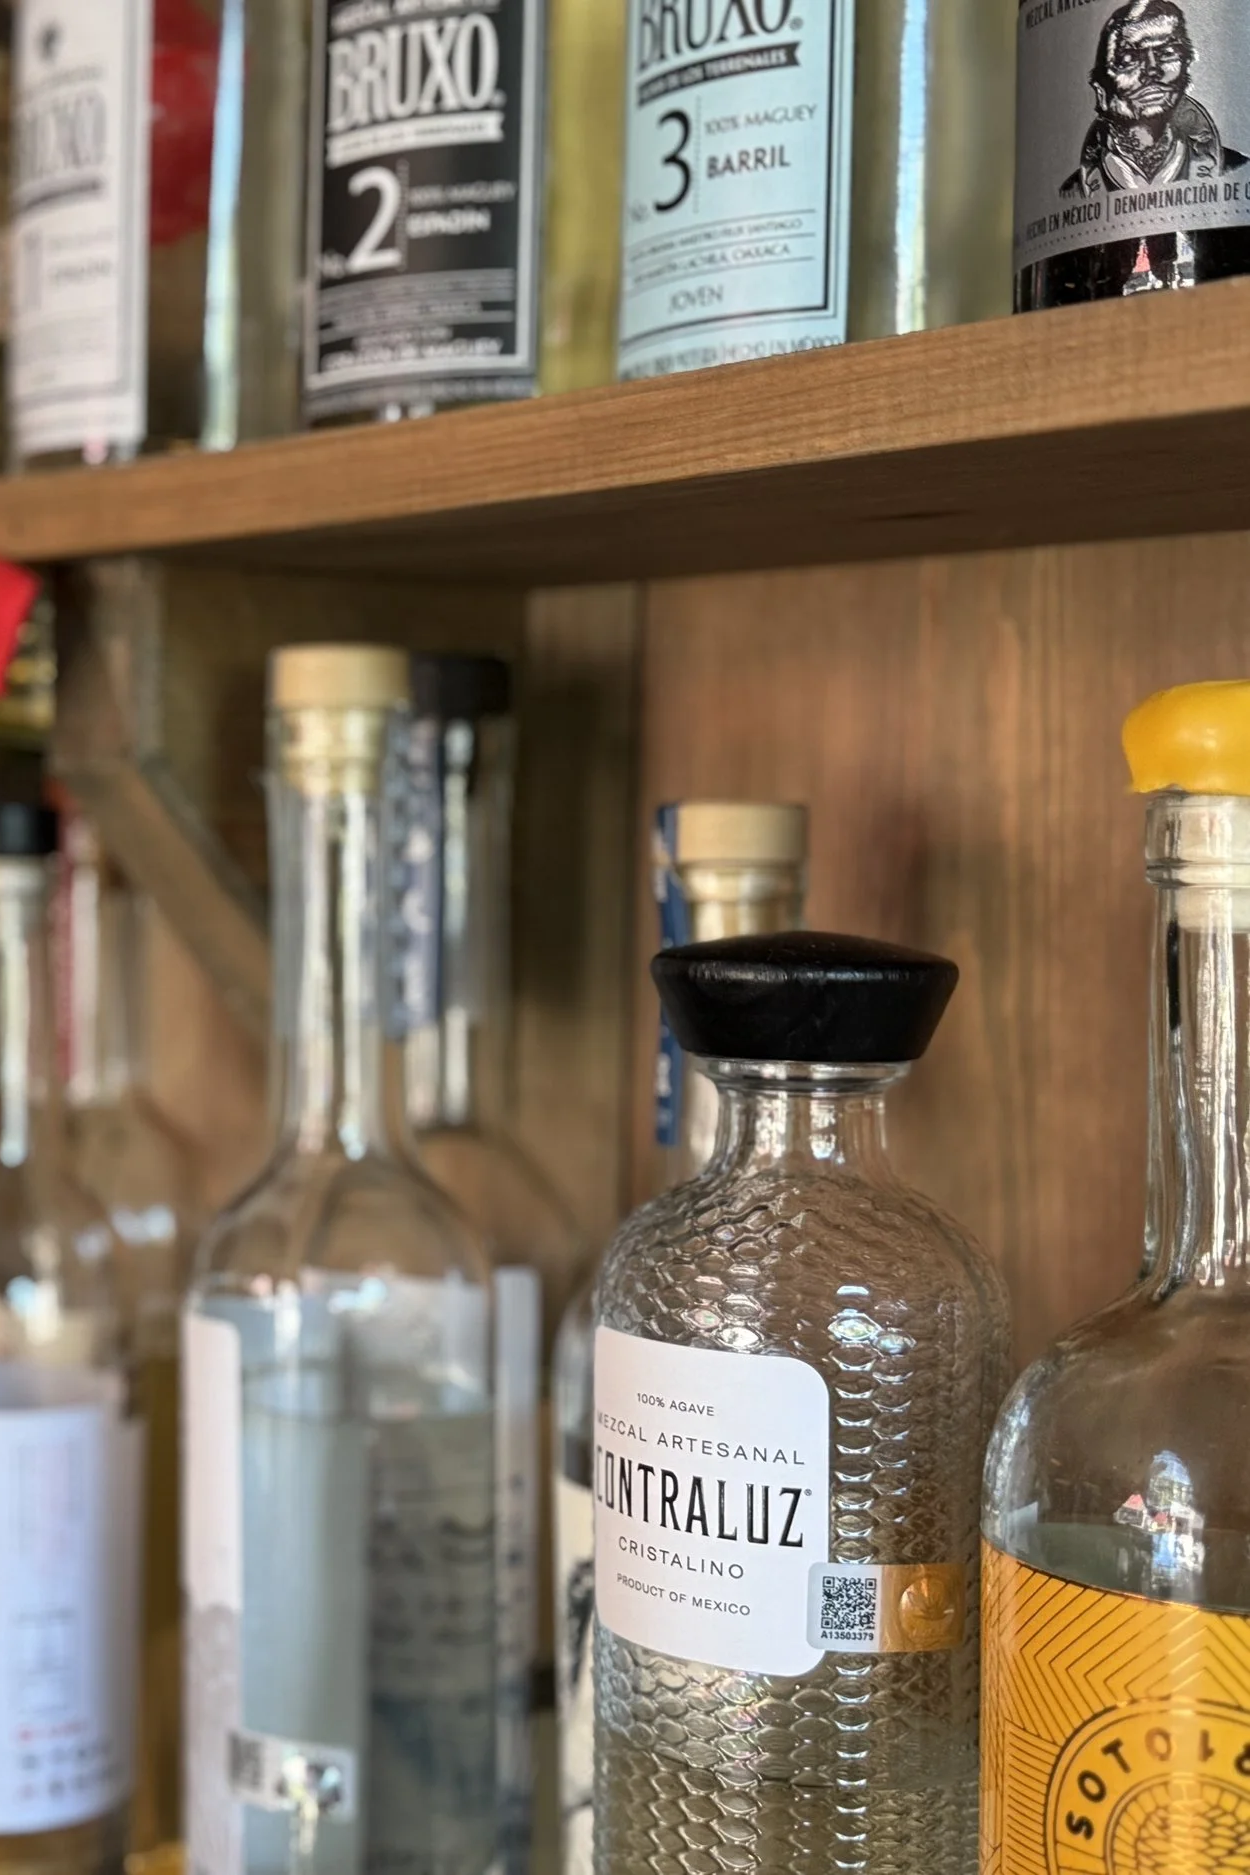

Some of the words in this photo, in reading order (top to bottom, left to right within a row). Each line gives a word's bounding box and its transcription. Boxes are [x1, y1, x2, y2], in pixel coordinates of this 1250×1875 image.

[327, 14, 499, 132] BRUXO
[744, 103, 818, 127] MAGUEY
[653, 108, 693, 214] 3
[706, 144, 791, 179] BARRIL
[348, 166, 402, 273] 2
[1049, 212, 1061, 231] EN
[1062, 202, 1100, 229] MÉXICO
[1114, 182, 1218, 216] DENOMINACIÓN
[1223, 181, 1241, 201] DE
[668, 284, 724, 313] JOVEN
[636, 1392, 666, 1409] 100%
[669, 1400, 716, 1418] AGAVE
[596, 1409, 648, 1443] MEZCAL
[656, 1431, 806, 1466] ARTESANAL
[597, 1445, 803, 1548] CONTRALUZ
[618, 1535, 745, 1580] CRISTALINO
[616, 1572, 665, 1600] PRODUCT
[668, 1590, 687, 1604] OF
[692, 1595, 751, 1617] MEXICO
[820, 1630, 875, 1641] A13503379
